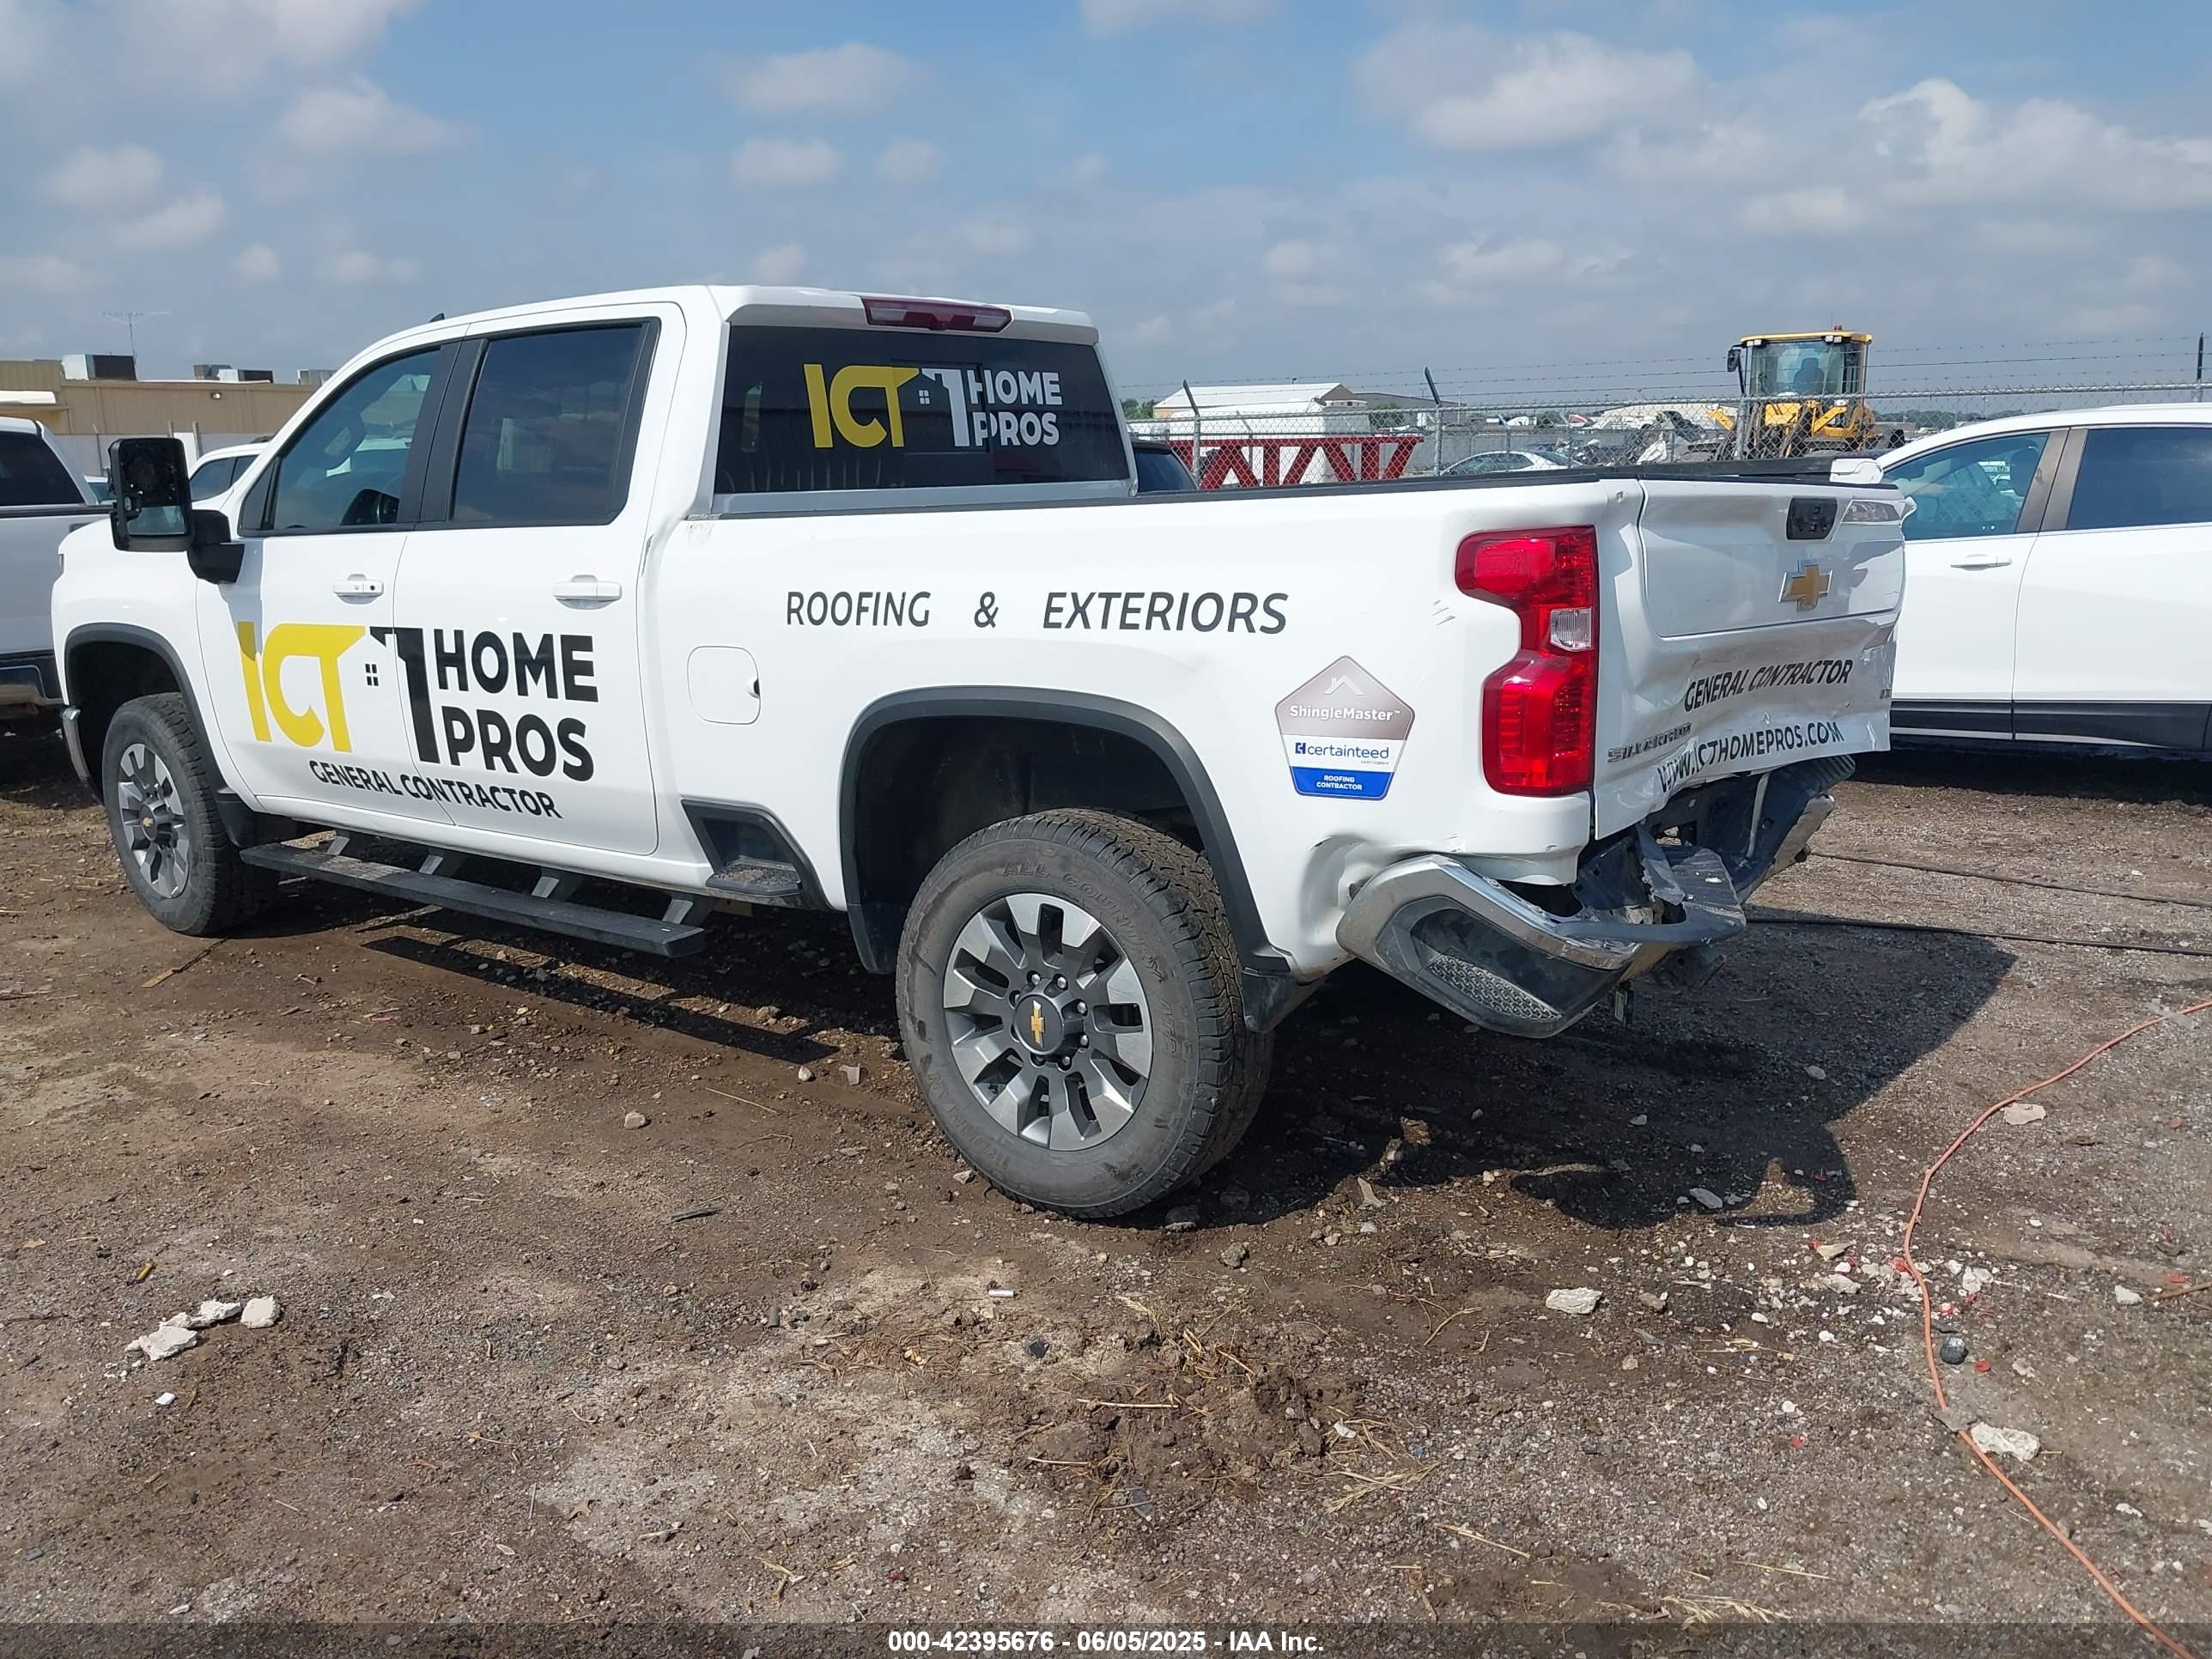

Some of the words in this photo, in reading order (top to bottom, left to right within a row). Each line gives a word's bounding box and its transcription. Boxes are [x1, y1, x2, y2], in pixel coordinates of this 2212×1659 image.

[804, 364, 919, 447] ICT
[967, 369, 1063, 406] HOME
[972, 412, 1060, 447] PROS
[787, 591, 931, 627] ROOFING
[974, 592, 999, 629] &
[1043, 592, 1289, 635] EXTERIORS
[237, 621, 366, 753] ICT
[434, 629, 599, 702] HOME
[1684, 669, 1749, 712] GENERAL
[1748, 659, 1854, 689] CONTRACTOR
[441, 705, 595, 781] PROS
[1307, 744, 1389, 759] certainteed
[309, 760, 402, 795] GENERAL
[400, 774, 563, 818] CONTRACTOR
[1003, 863, 1049, 878] ALL
